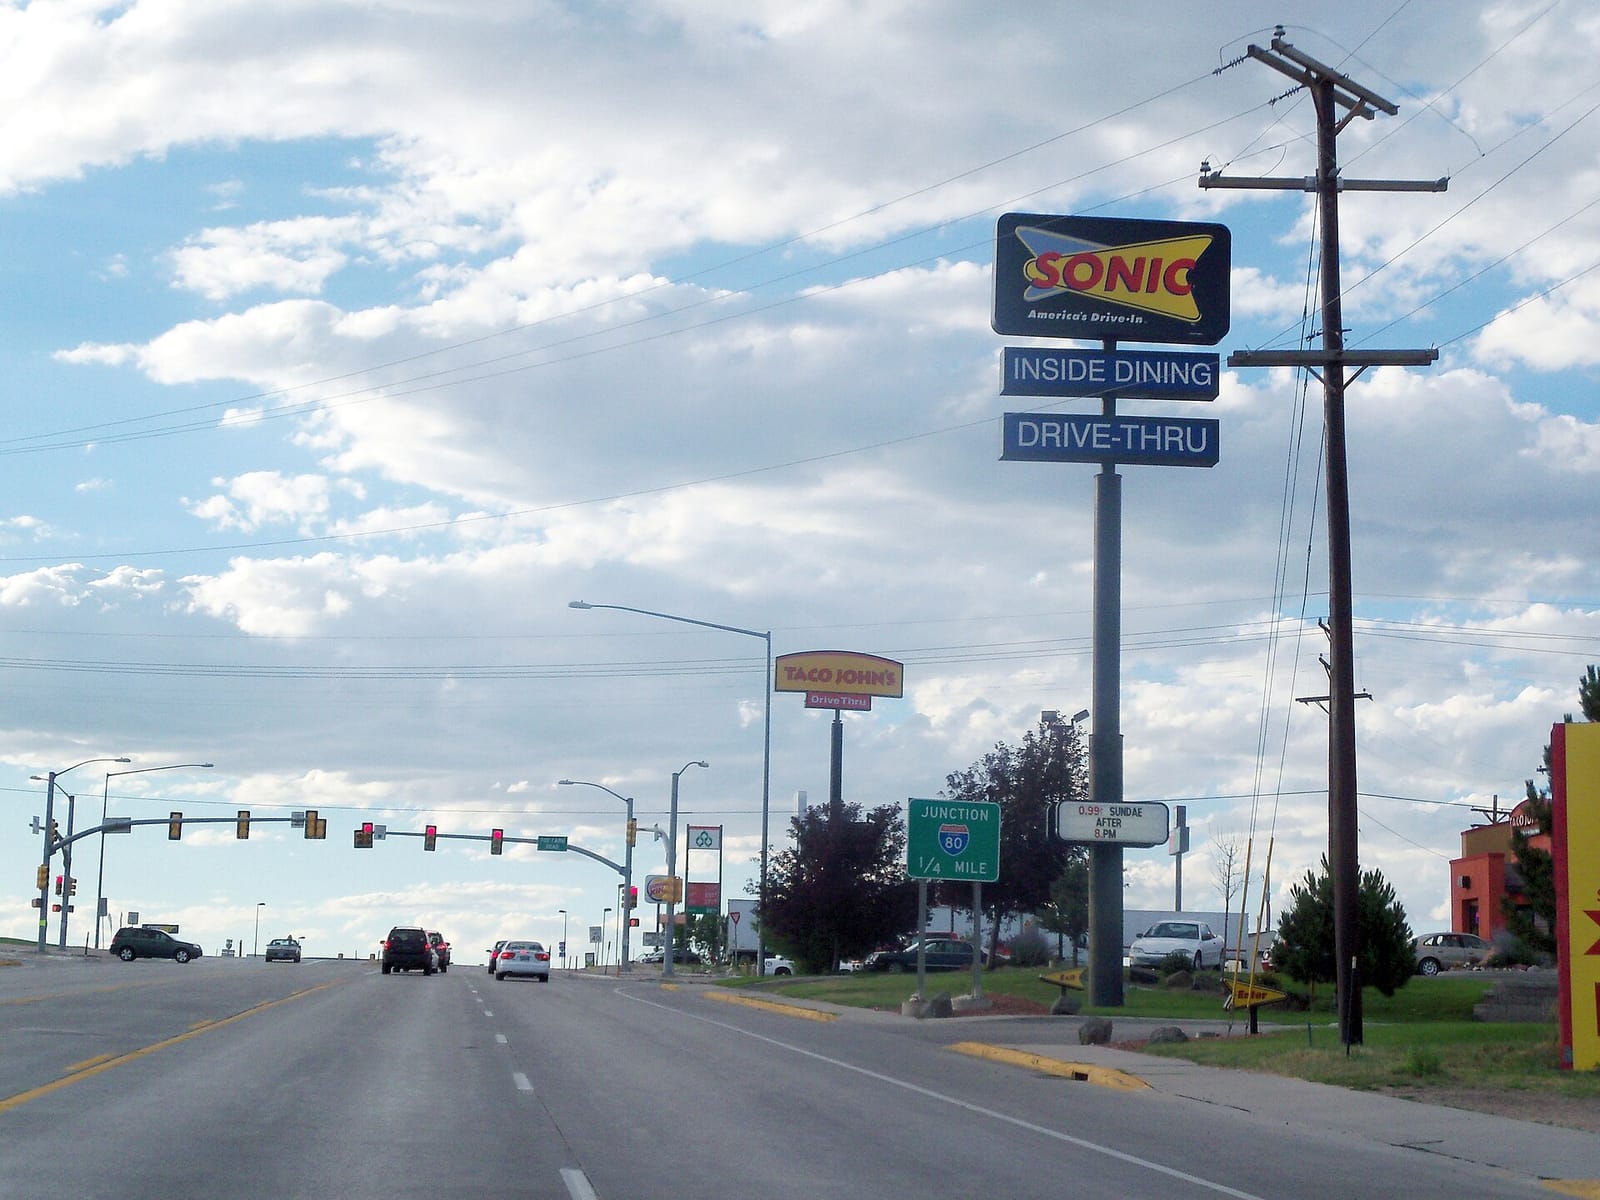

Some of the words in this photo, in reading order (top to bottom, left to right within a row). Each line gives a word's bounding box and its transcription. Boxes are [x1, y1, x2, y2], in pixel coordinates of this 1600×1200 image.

[1032, 252, 1196, 295] SONIC
[1027, 309, 1088, 322] America's
[1014, 358, 1105, 382] INSIDE
[1115, 359, 1213, 386] DINING
[1017, 421, 1208, 453] DRIVE-THRU
[784, 666, 833, 682] TACO
[836, 668, 896, 686] JOHN'S
[811, 695, 840, 705] Drive
[841, 696, 867, 706] Thru
[921, 806, 989, 821] JUNCTION
[1109, 806, 1143, 817] SUNDAE
[1096, 817, 1122, 828] AFTER
[945, 836, 963, 850] 80
[919, 856, 941, 875] 1/4
[955, 861, 987, 874] MILE
